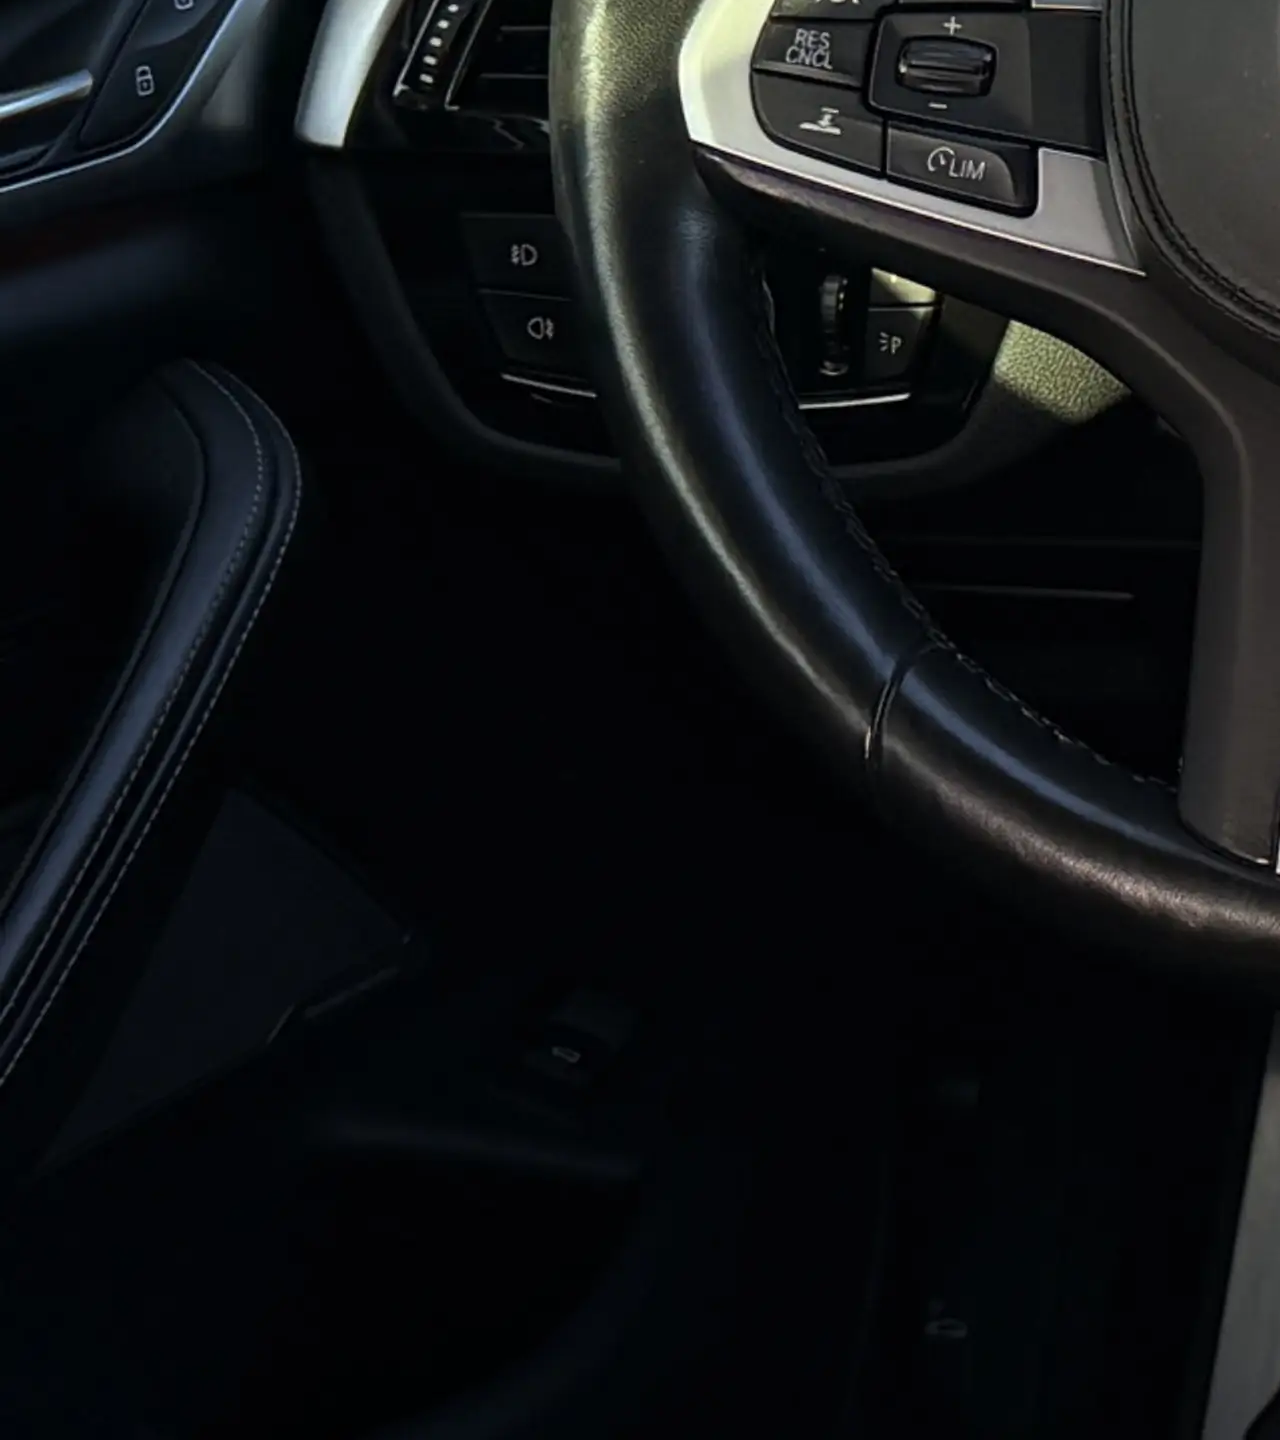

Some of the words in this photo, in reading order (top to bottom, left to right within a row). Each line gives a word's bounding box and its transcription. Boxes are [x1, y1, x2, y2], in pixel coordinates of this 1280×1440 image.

[794, 28, 831, 51] RES
[785, 46, 833, 71] CNCL
[948, 157, 986, 182] LIM
